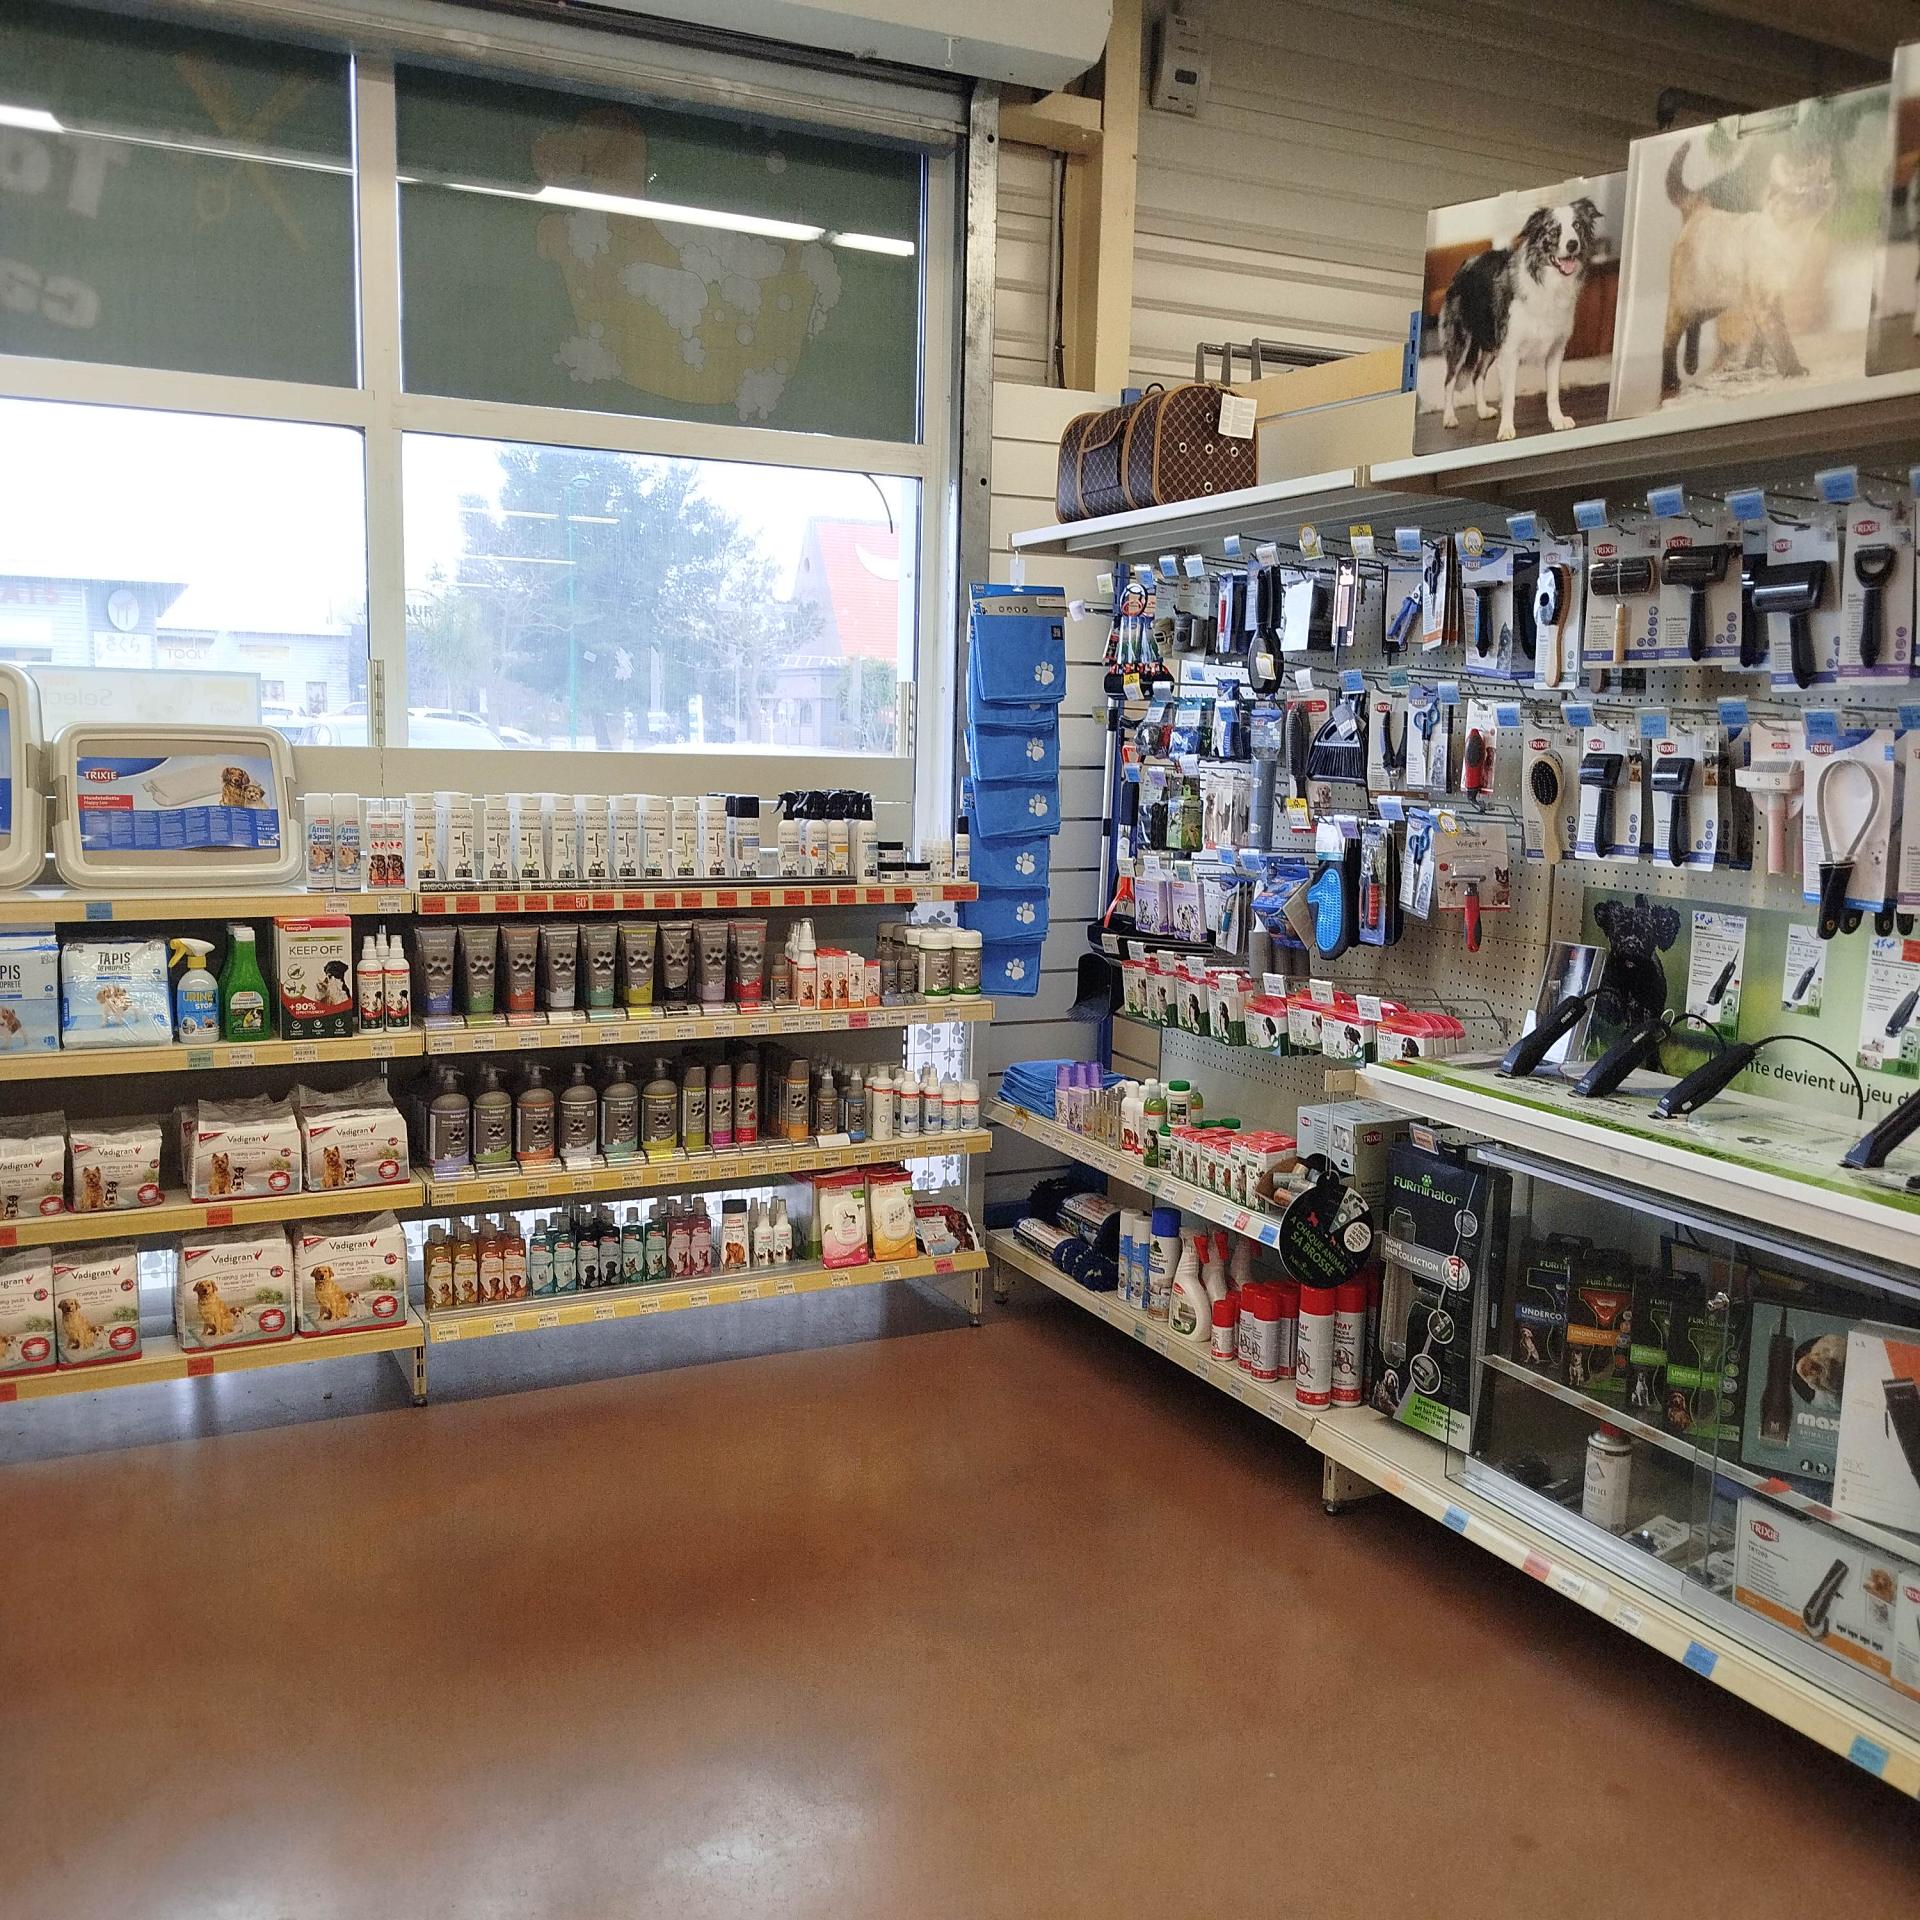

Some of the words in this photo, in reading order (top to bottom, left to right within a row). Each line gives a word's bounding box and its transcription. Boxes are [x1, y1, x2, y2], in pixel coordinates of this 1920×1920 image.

[1853, 523, 1881, 533] TRIXIE
[1666, 538, 1693, 547] TRIXIE
[1771, 541, 1793, 550] TRIXIE
[1593, 546, 1617, 555] TRIXIE
[1529, 740, 1551, 749] TRIXIE
[1587, 741, 1606, 749] TRIXIE
[1656, 745, 1678, 753] TRIXIE
[1810, 744, 1834, 754] TRIXIE
[84, 770, 117, 781] TRIXIE
[1774, 777, 1781, 786] S
[289, 945, 318, 956] KEEP
[320, 945, 344, 955] OFF
[98, 952, 131, 966] TAPIS
[195, 1002, 213, 1010] STOP
[289, 1002, 317, 1011] +90%
[1774, 1063, 1836, 1092] devient
[1840, 1080, 1861, 1098] un
[1864, 1083, 1893, 1104] jeu
[336, 1127, 369, 1138] Vadigran
[1363, 1131, 1385, 1143] TRIXIE
[226, 1135, 261, 1146] Vadigran
[98, 1147, 134, 1159] Vadigran
[1393, 1174, 1461, 1206] FURminator
[329, 1239, 368, 1252] Vadigran
[1296, 1221, 1324, 1250] CHAQUE
[1321, 1248, 1349, 1276] ANIMAL
[1385, 1238, 1402, 1251] HOME
[212, 1252, 253, 1266] Vadigran
[1290, 1231, 1304, 1247] SA
[1302, 1243, 1335, 1277] BROSSE
[1385, 1246, 1399, 1257] HAIR
[1399, 1250, 1439, 1273] COLLECTION
[72, 1268, 111, 1281] Vadigran
[1521, 1306, 1566, 1321] UNDERCO
[1800, 1429, 1824, 1440] ANIMAL
[1750, 1520, 1780, 1543] TRIXIE
